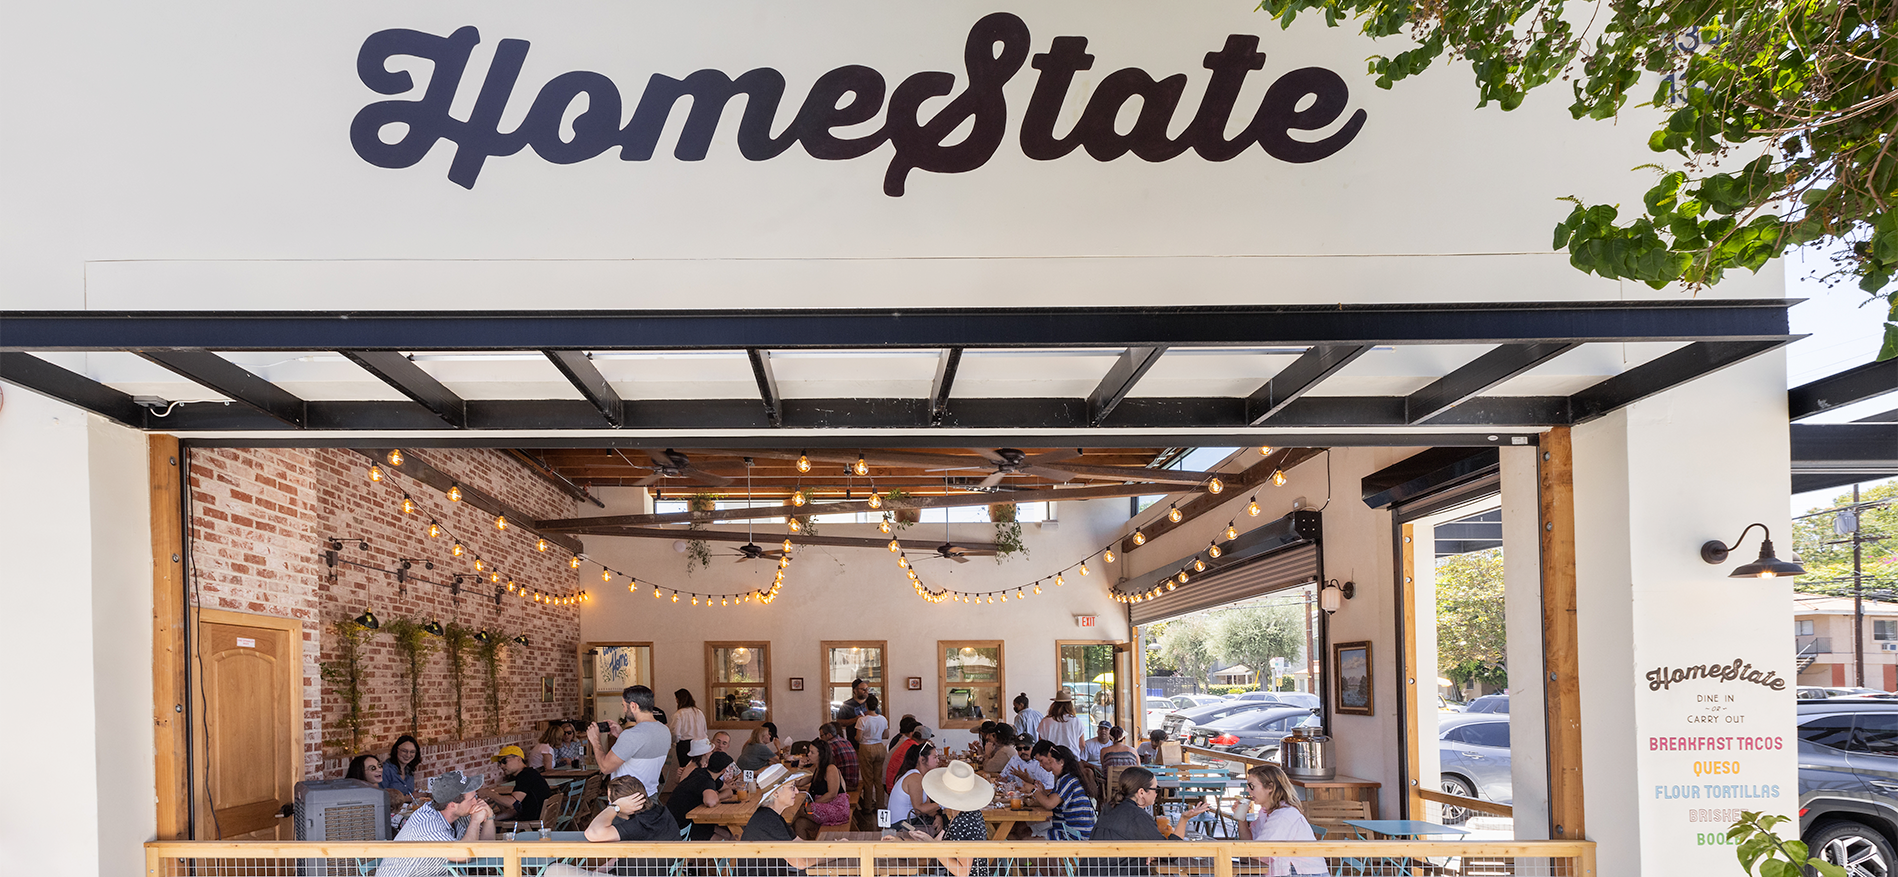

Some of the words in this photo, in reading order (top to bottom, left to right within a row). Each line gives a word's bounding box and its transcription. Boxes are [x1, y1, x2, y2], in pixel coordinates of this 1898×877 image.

[350, 12, 1368, 197] HomeState
[1081, 616, 1095, 627] EXIT
[1646, 658, 1786, 691] HomeState
[1697, 695, 1719, 703] DINE
[1725, 695, 1735, 703] IN
[1687, 715, 1719, 724] CARRY
[1725, 715, 1745, 724] OUT
[1650, 737, 1734, 751] BREAKFAST
[1736, 737, 1783, 750] TACOS
[1693, 761, 1740, 777] QUESO
[1655, 785, 1700, 799] FLOUR
[1704, 785, 1780, 799] TORTILLAS
[880, 811, 888, 822] 47
[1689, 809, 1749, 822] BRISKE
